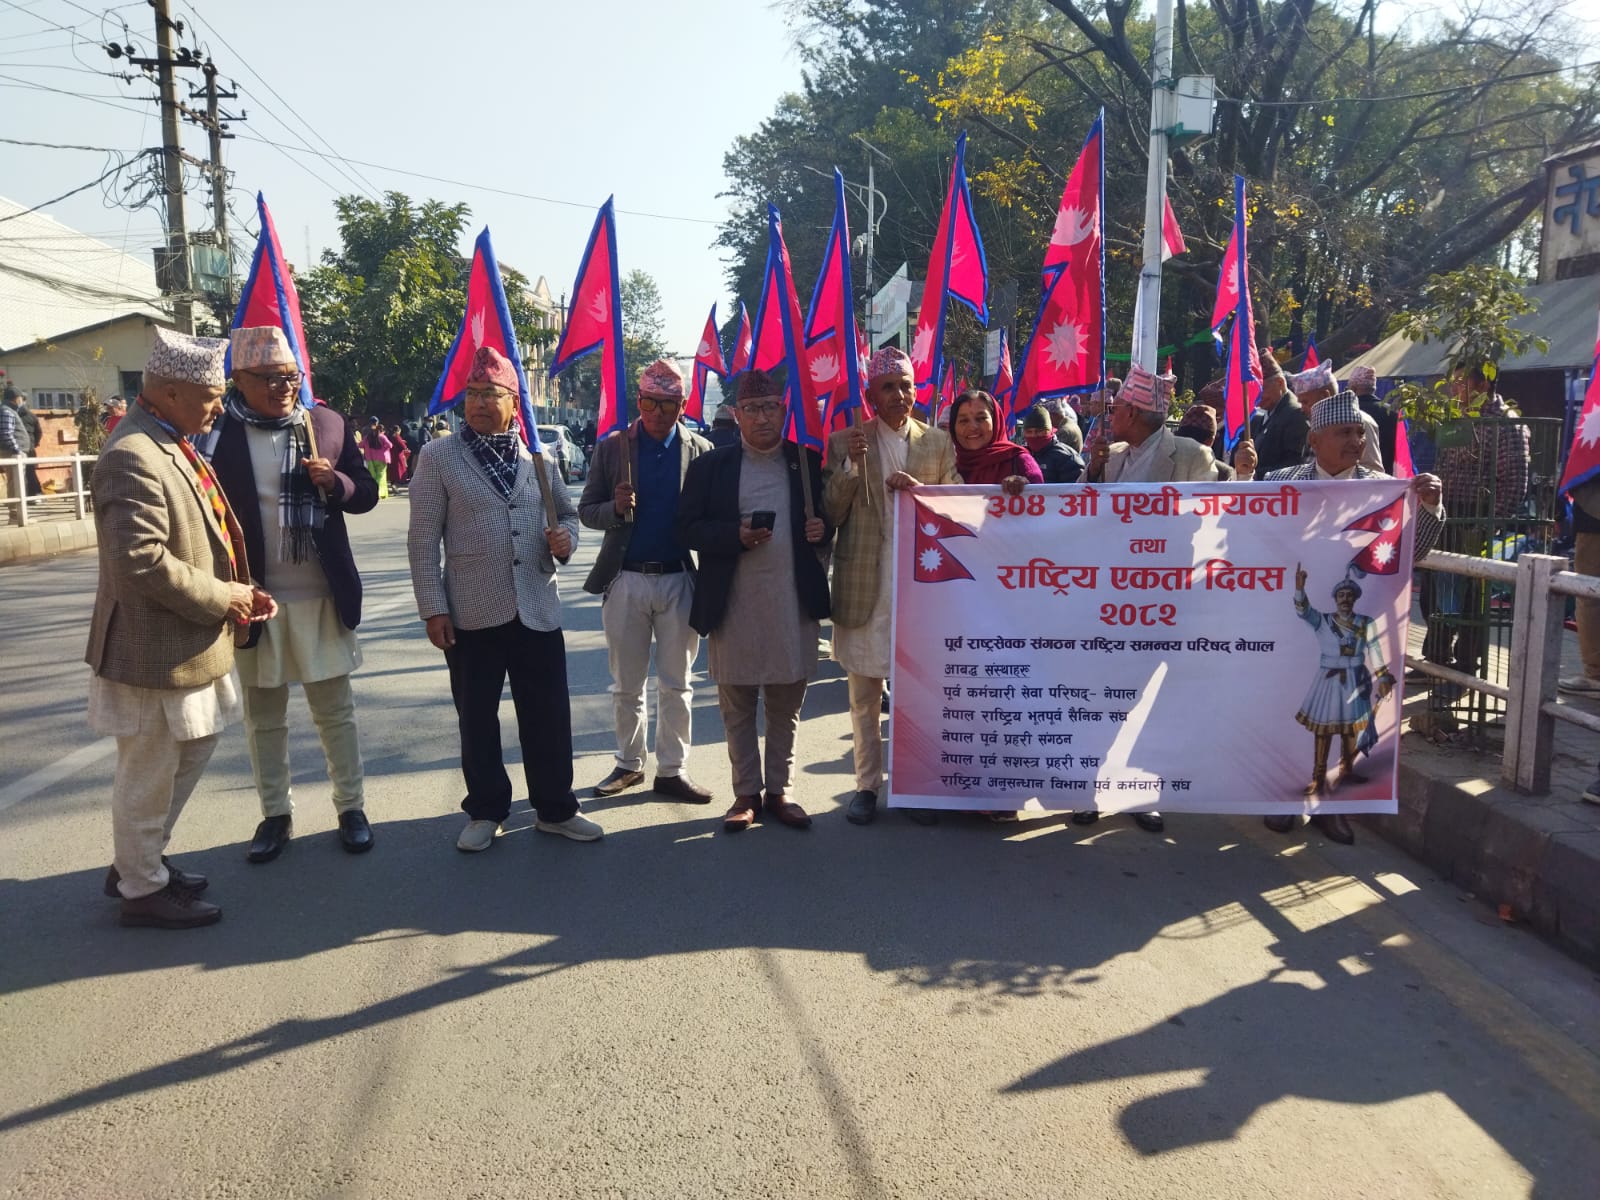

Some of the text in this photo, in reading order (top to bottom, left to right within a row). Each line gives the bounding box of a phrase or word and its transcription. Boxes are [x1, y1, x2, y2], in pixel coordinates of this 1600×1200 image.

[988, 495, 1045, 518] ३०४
[1110, 486, 1183, 523] पृथ्वी
[1192, 485, 1301, 517] जयन्ती
[1129, 538, 1167, 554] तथा
[997, 558, 1287, 596] राष्ट्रिय एकता दिवस
[1100, 603, 1177, 626] २०८२
[945, 636, 1275, 653] पूर्व राष्ट्रसेवक संगठन राष्ट्रिय समन्वय परिषद् नेपाल
[943, 684, 961, 700] पूर्व
[967, 684, 1016, 701] कर्मचारी
[1021, 685, 1043, 700] सेवा
[1104, 686, 1137, 700] नेपाल
[942, 707, 1129, 726] नेपाल राष्ट्रिय भूतपूर्व सैनिक संघ
[941, 729, 1073, 746] नेपाल पूर्व प्रहरी संगठन
[941, 751, 1100, 770] नेपाल पूर्व सशस्त्र प्रहरी संघ
[940, 773, 982, 789] राष्ट्रिय
[1051, 776, 1088, 790] विभाग
[1094, 777, 1111, 793] पूर्व
[1117, 777, 1166, 792] कर्मचारी
[1171, 779, 1192, 791] संघ
